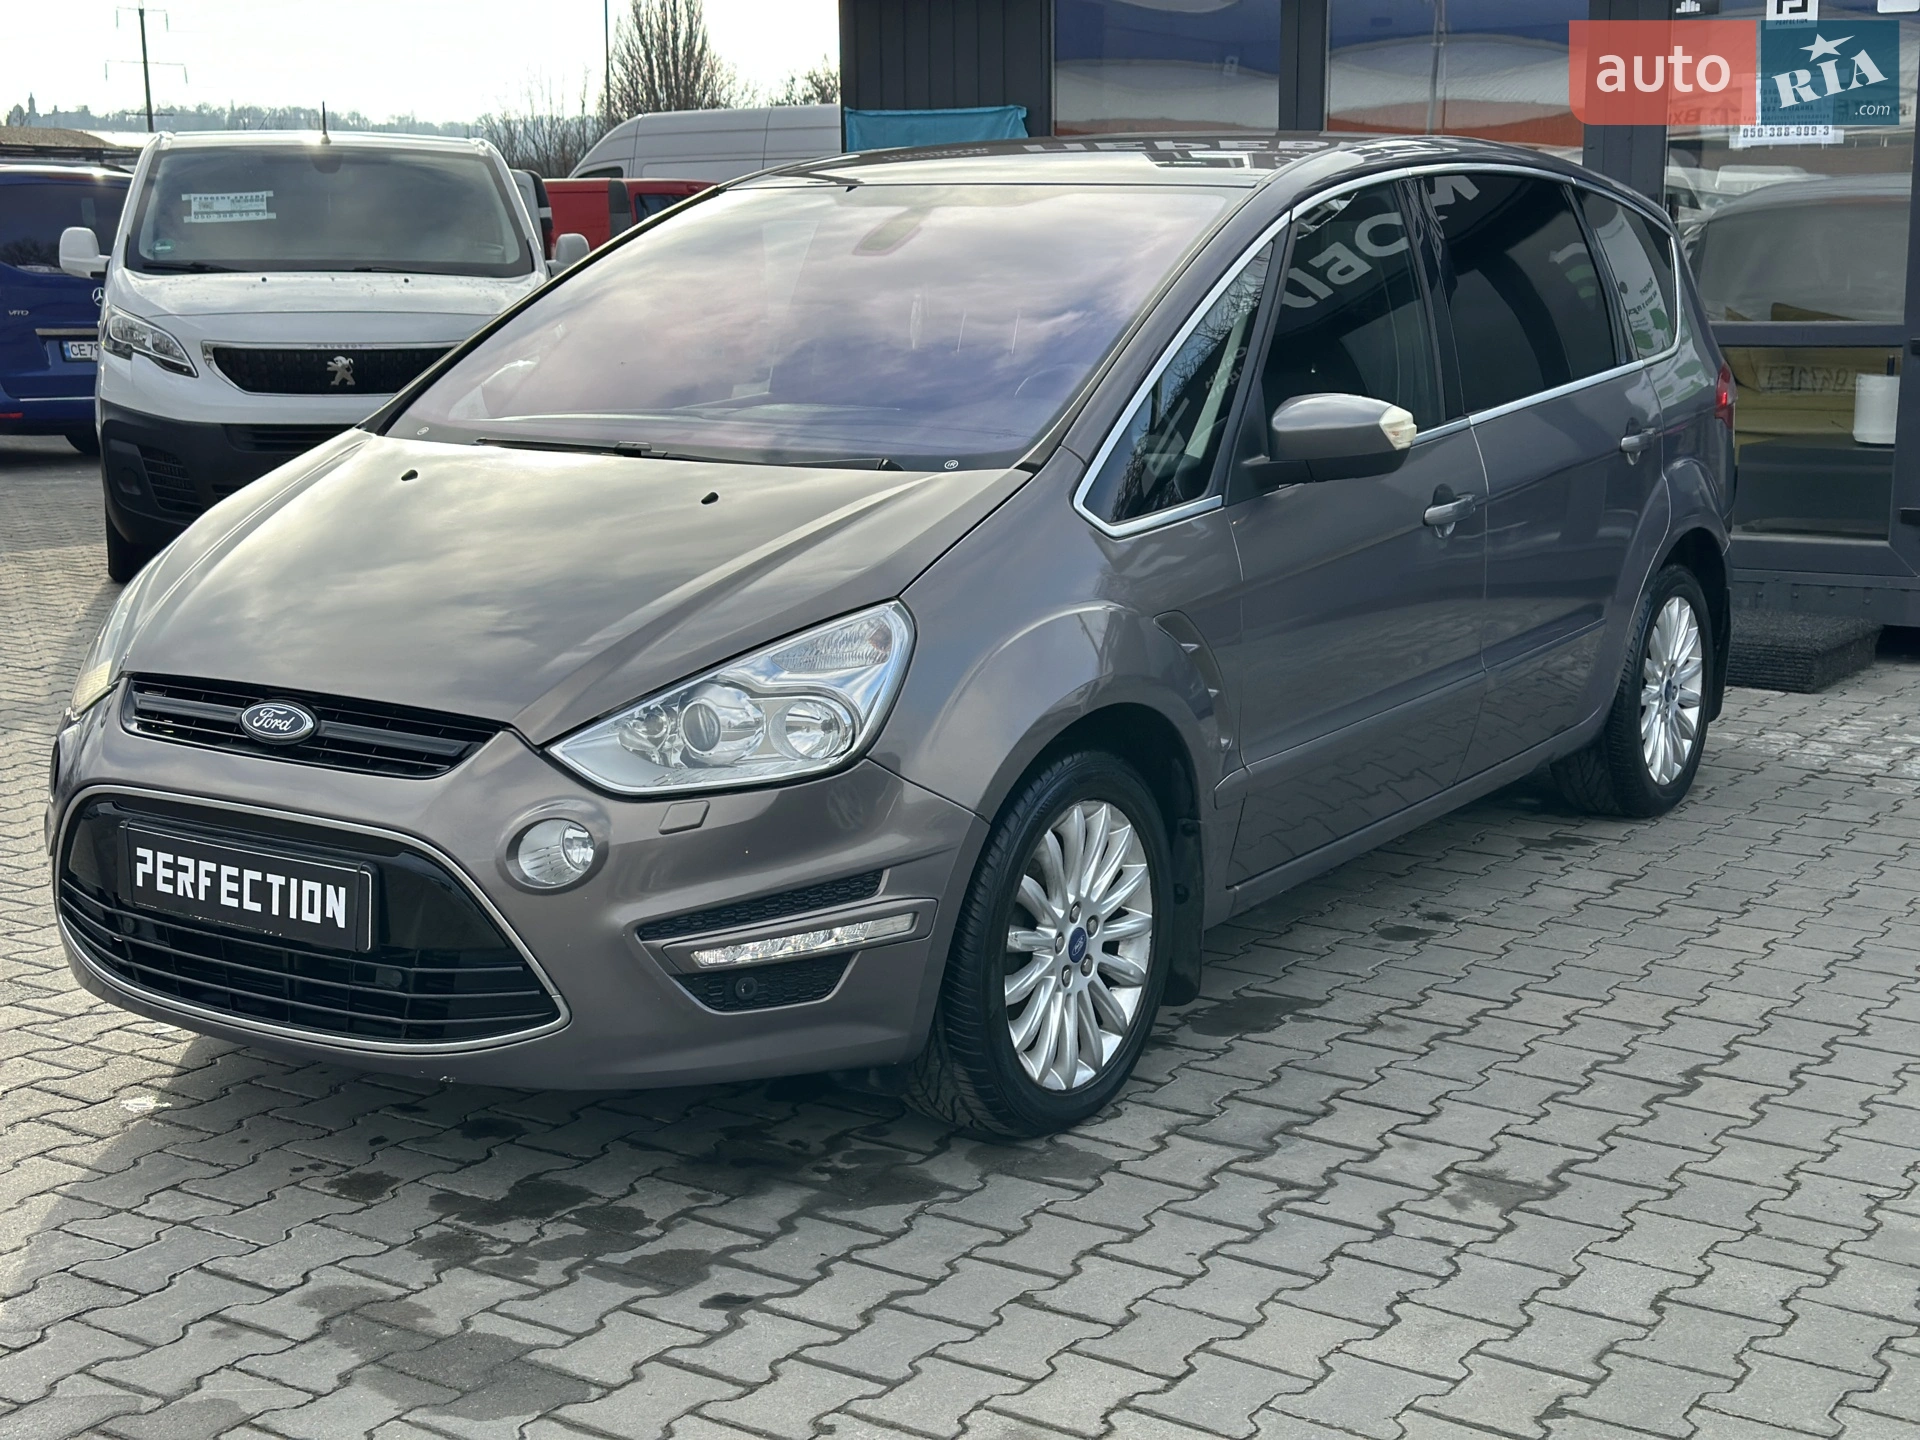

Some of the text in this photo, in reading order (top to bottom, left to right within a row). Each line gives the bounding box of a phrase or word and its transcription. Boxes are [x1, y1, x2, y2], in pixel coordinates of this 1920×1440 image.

[1743, 126, 1830, 138] 050-388-999-3
[252, 707, 295, 731] Ford
[135, 846, 346, 929] PERFECTION
